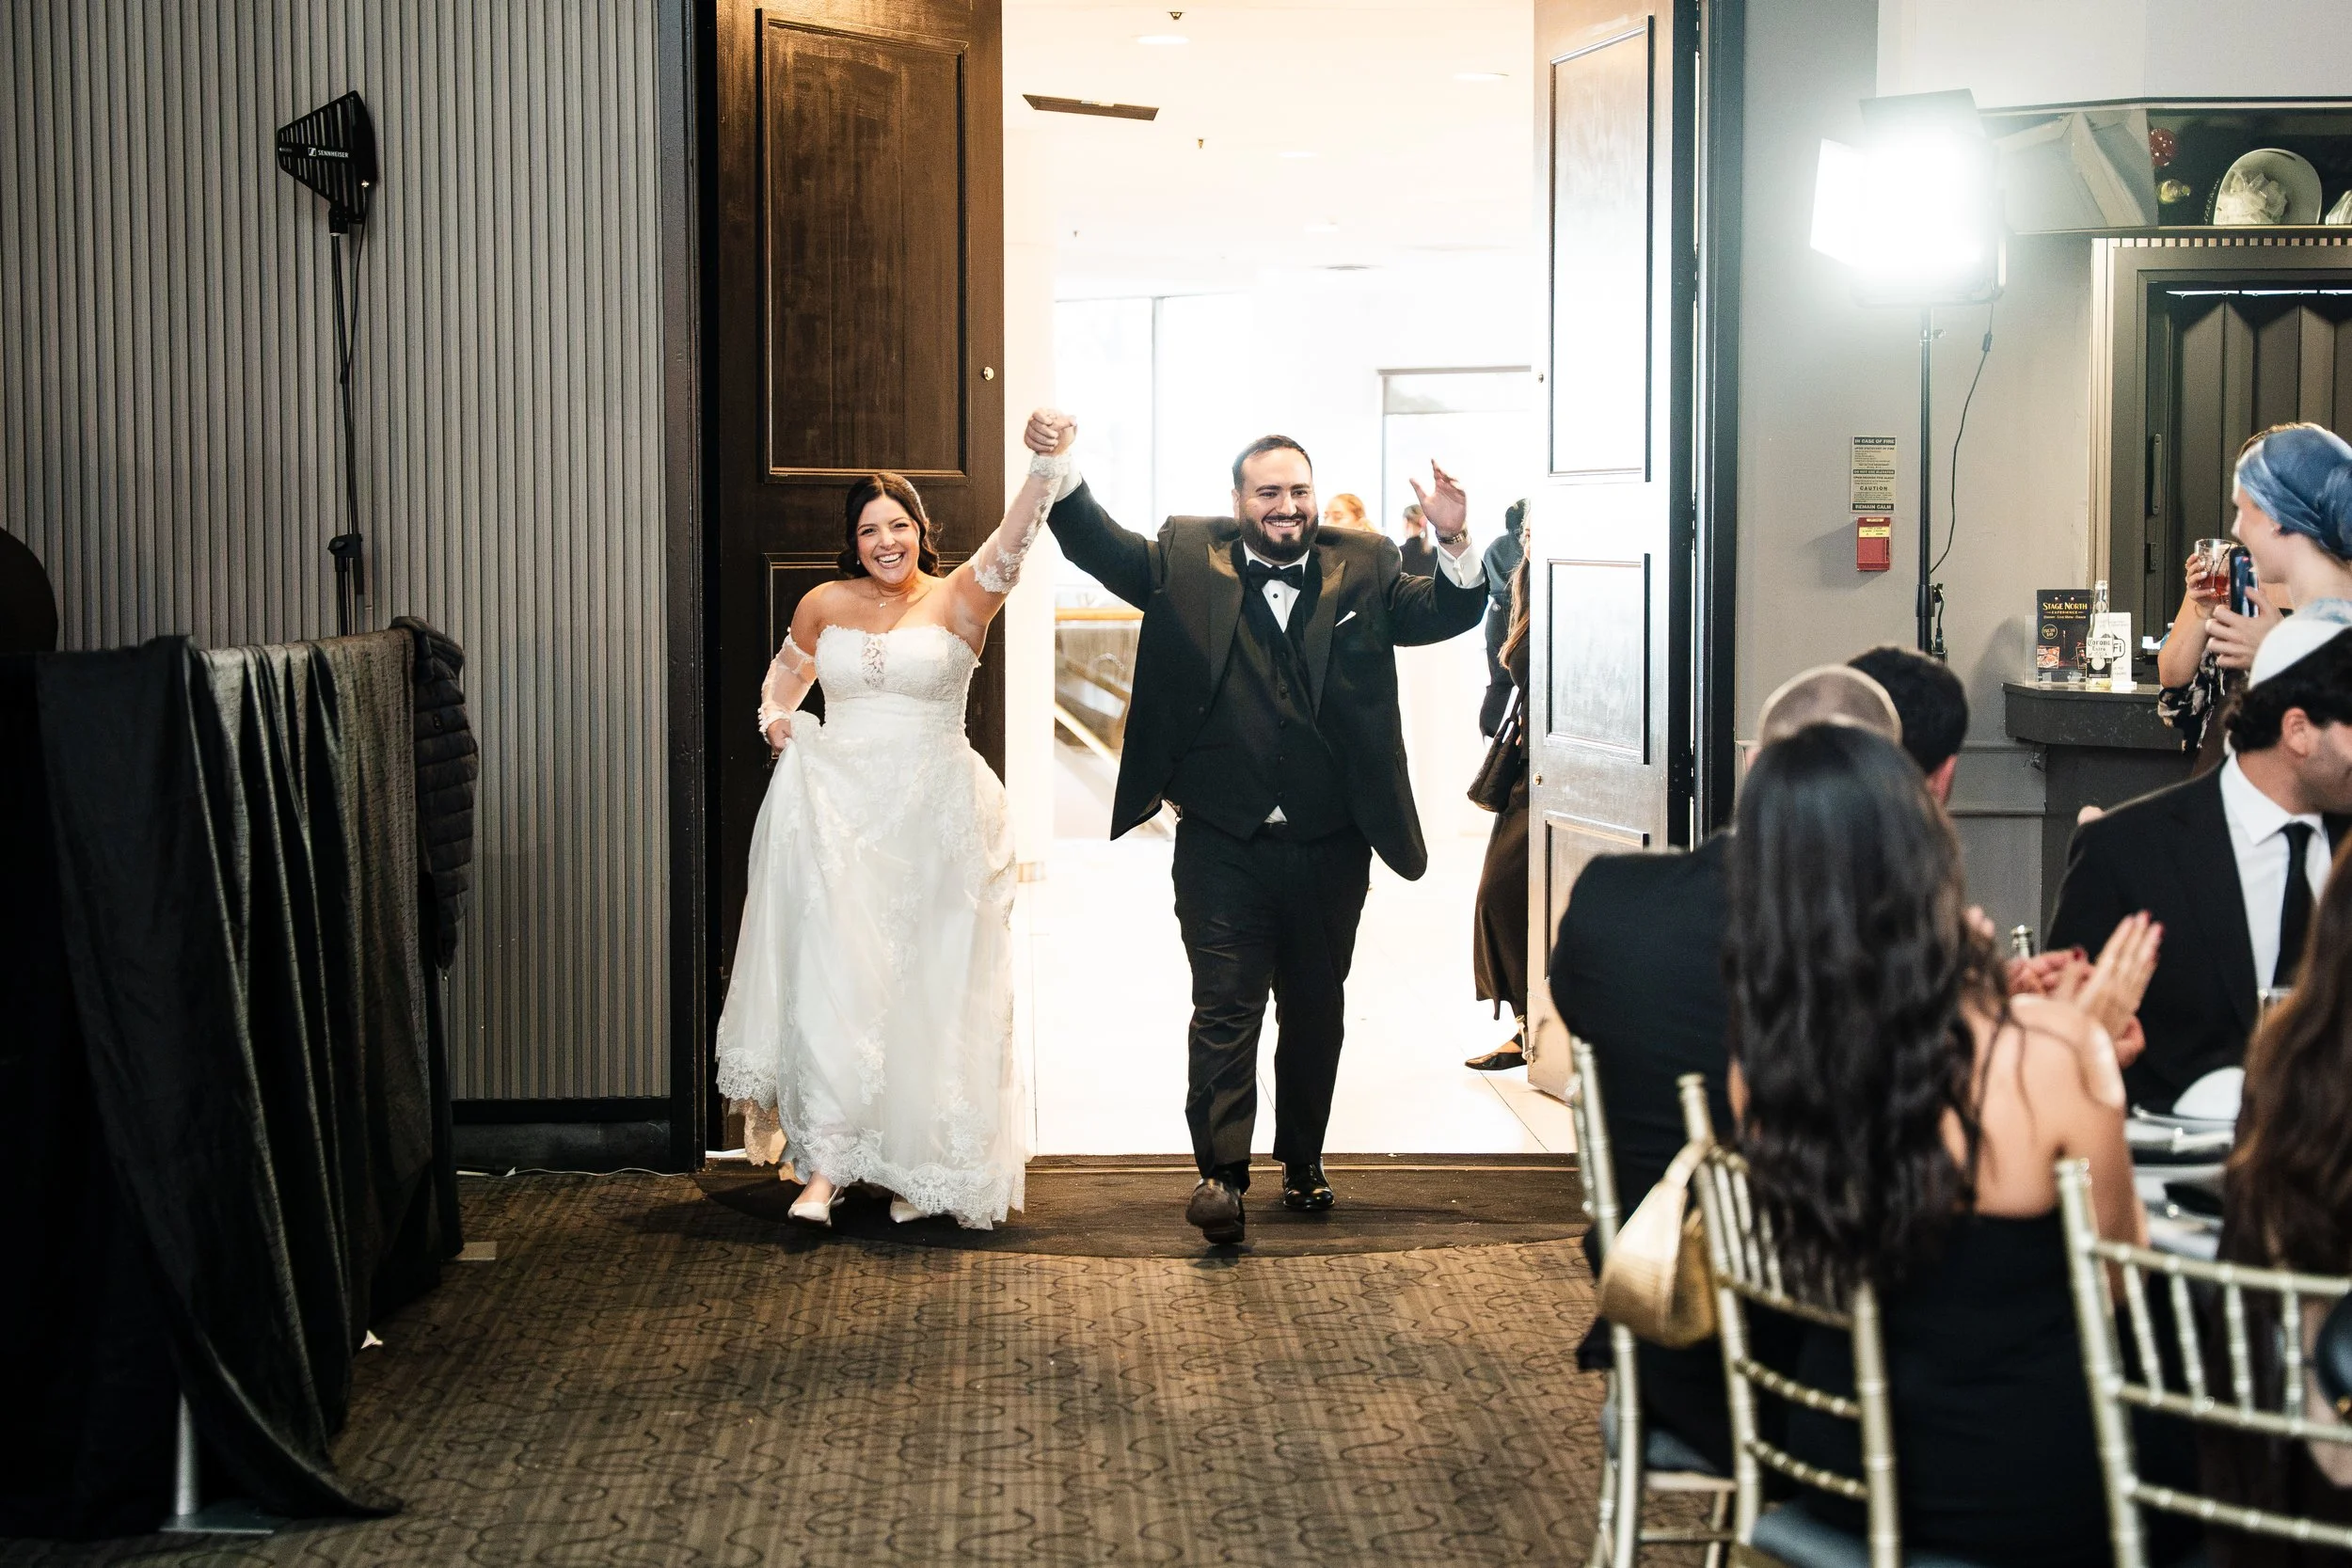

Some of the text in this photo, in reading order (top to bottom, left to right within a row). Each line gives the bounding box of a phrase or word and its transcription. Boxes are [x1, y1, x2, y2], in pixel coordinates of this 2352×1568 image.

[317, 150, 349, 158] SENNHEISER
[2042, 602, 2088, 610] STAGE NORTH
